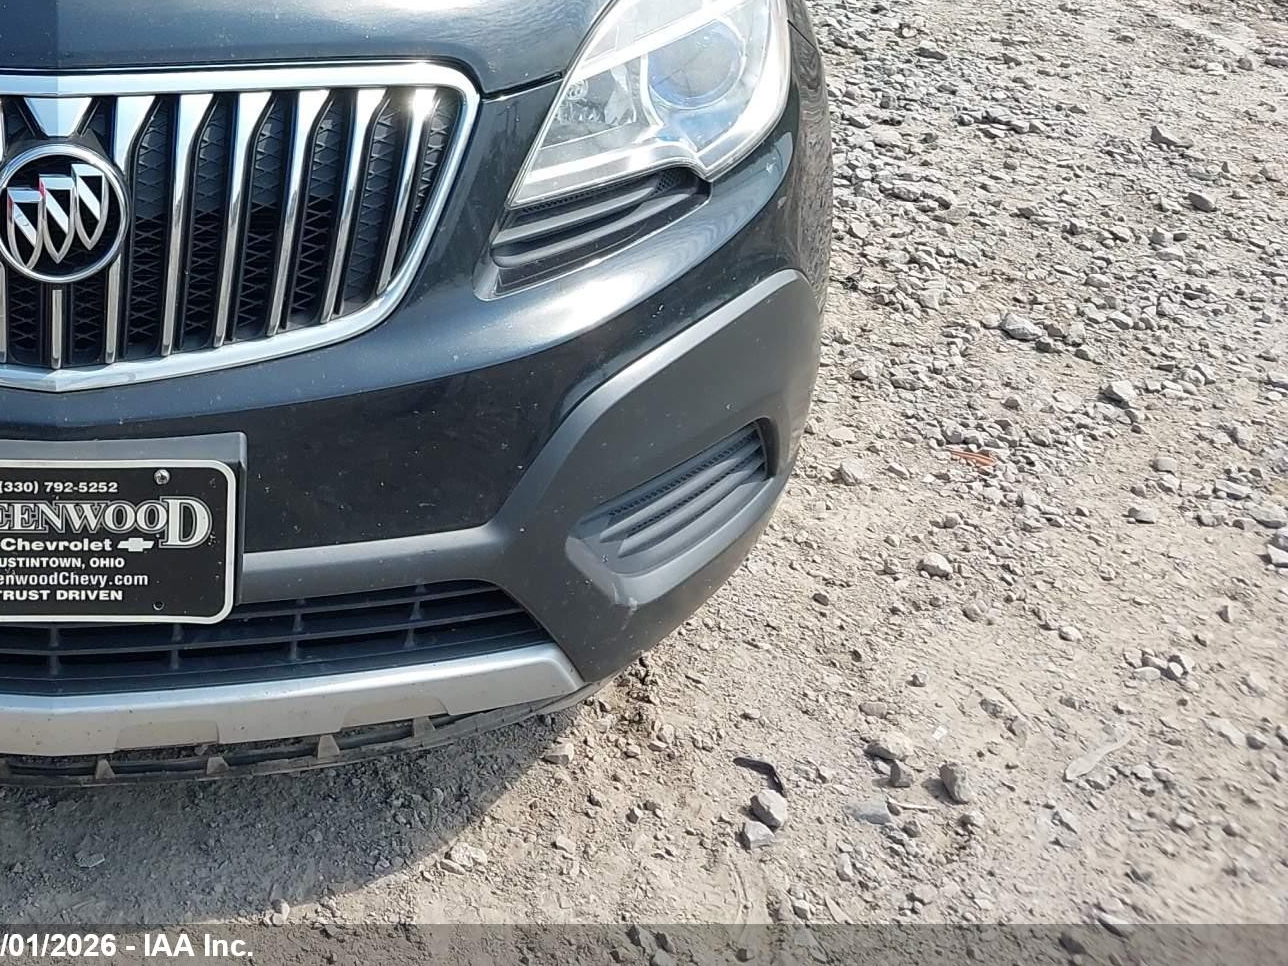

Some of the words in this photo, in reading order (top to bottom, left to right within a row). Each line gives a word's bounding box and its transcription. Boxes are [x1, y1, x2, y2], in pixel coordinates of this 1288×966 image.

[44, 481, 118, 494] 792-5252
[0, 537, 112, 551] Chevrolet
[89, 557, 125, 568] OHIO
[56, 589, 123, 601] DRIVEN
